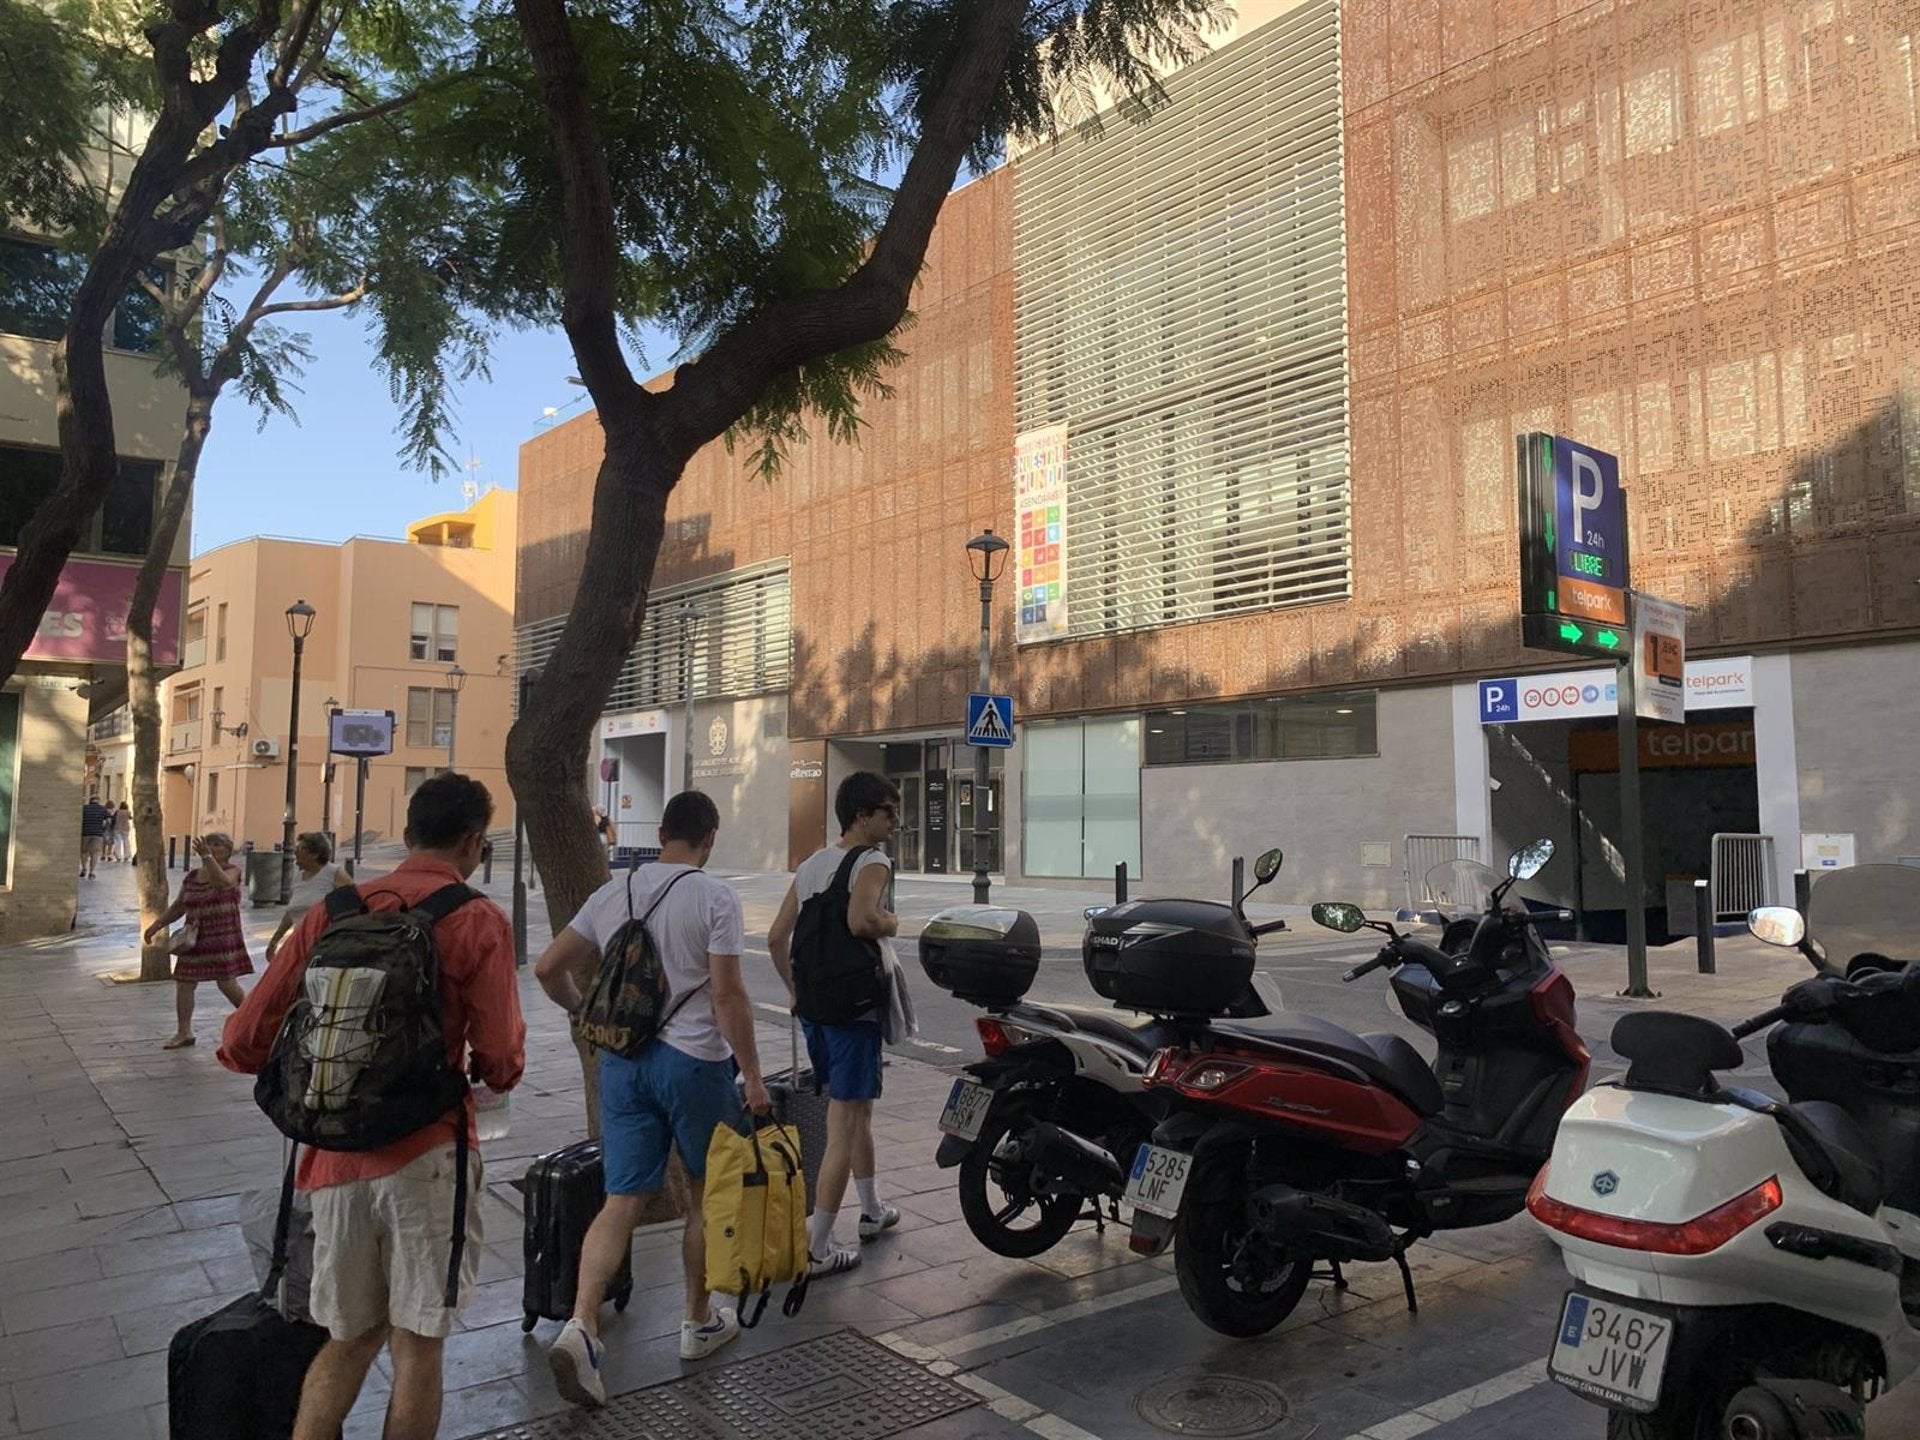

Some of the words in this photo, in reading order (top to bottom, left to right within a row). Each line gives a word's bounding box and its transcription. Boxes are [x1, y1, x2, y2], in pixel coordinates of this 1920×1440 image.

[1571, 449, 1604, 544] P
[1586, 529, 1605, 550] 24h
[1574, 554, 1603, 577] LIBRE
[1572, 586, 1612, 612] telpark
[40, 611, 84, 638] ES
[1686, 671, 1745, 689] telpark
[1486, 686, 1505, 714] P
[1495, 703, 1511, 713] 24h
[1647, 726, 1754, 761] telpar
[959, 1085, 991, 1110] 8877
[1146, 1151, 1187, 1181] 5285
[1138, 1174, 1170, 1203] LNF
[1588, 1307, 1666, 1355] 3467
[1588, 1347, 1647, 1390] JVW
[1580, 1381, 1605, 1399] CENTER
